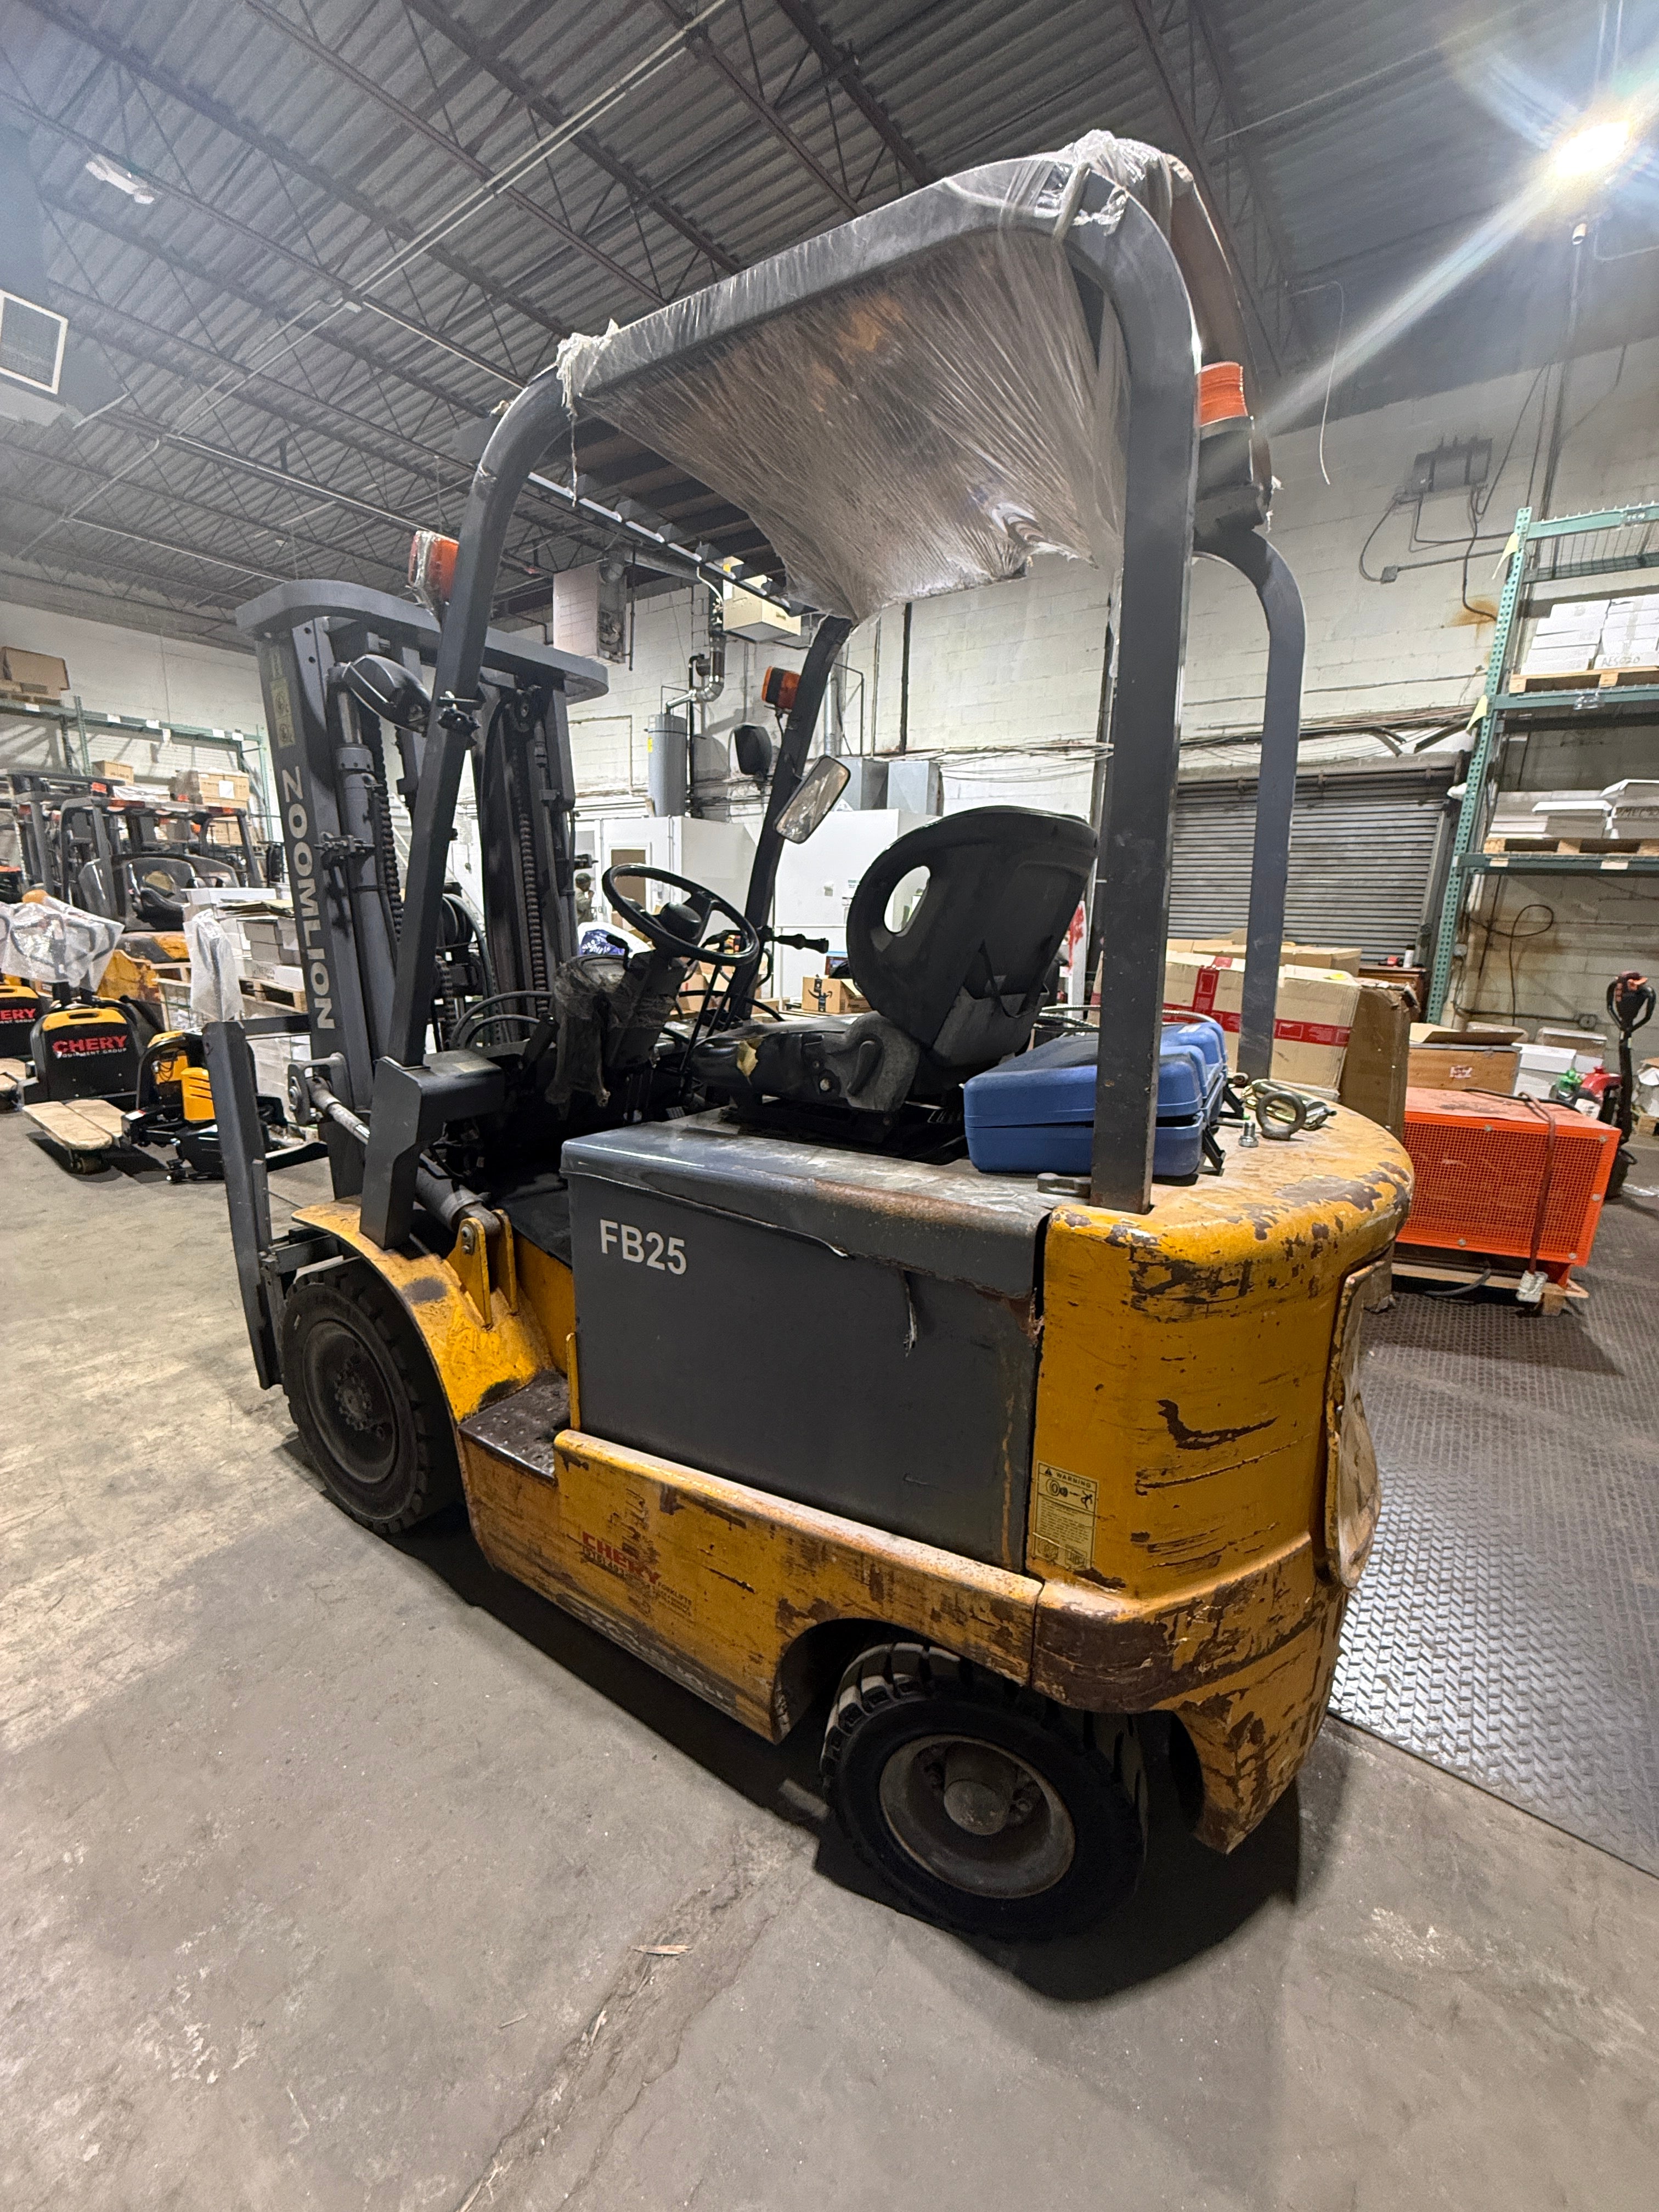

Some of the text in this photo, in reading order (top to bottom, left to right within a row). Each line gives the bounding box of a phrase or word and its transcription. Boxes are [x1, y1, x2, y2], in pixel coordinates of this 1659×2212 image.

[281, 766, 335, 1030] ZOOMLION
[0, 1008, 36, 1020] ERY
[52, 1035, 127, 1053] CHERY
[600, 1219, 686, 1275] FB25
[1056, 1472, 1091, 1488] WARNING
